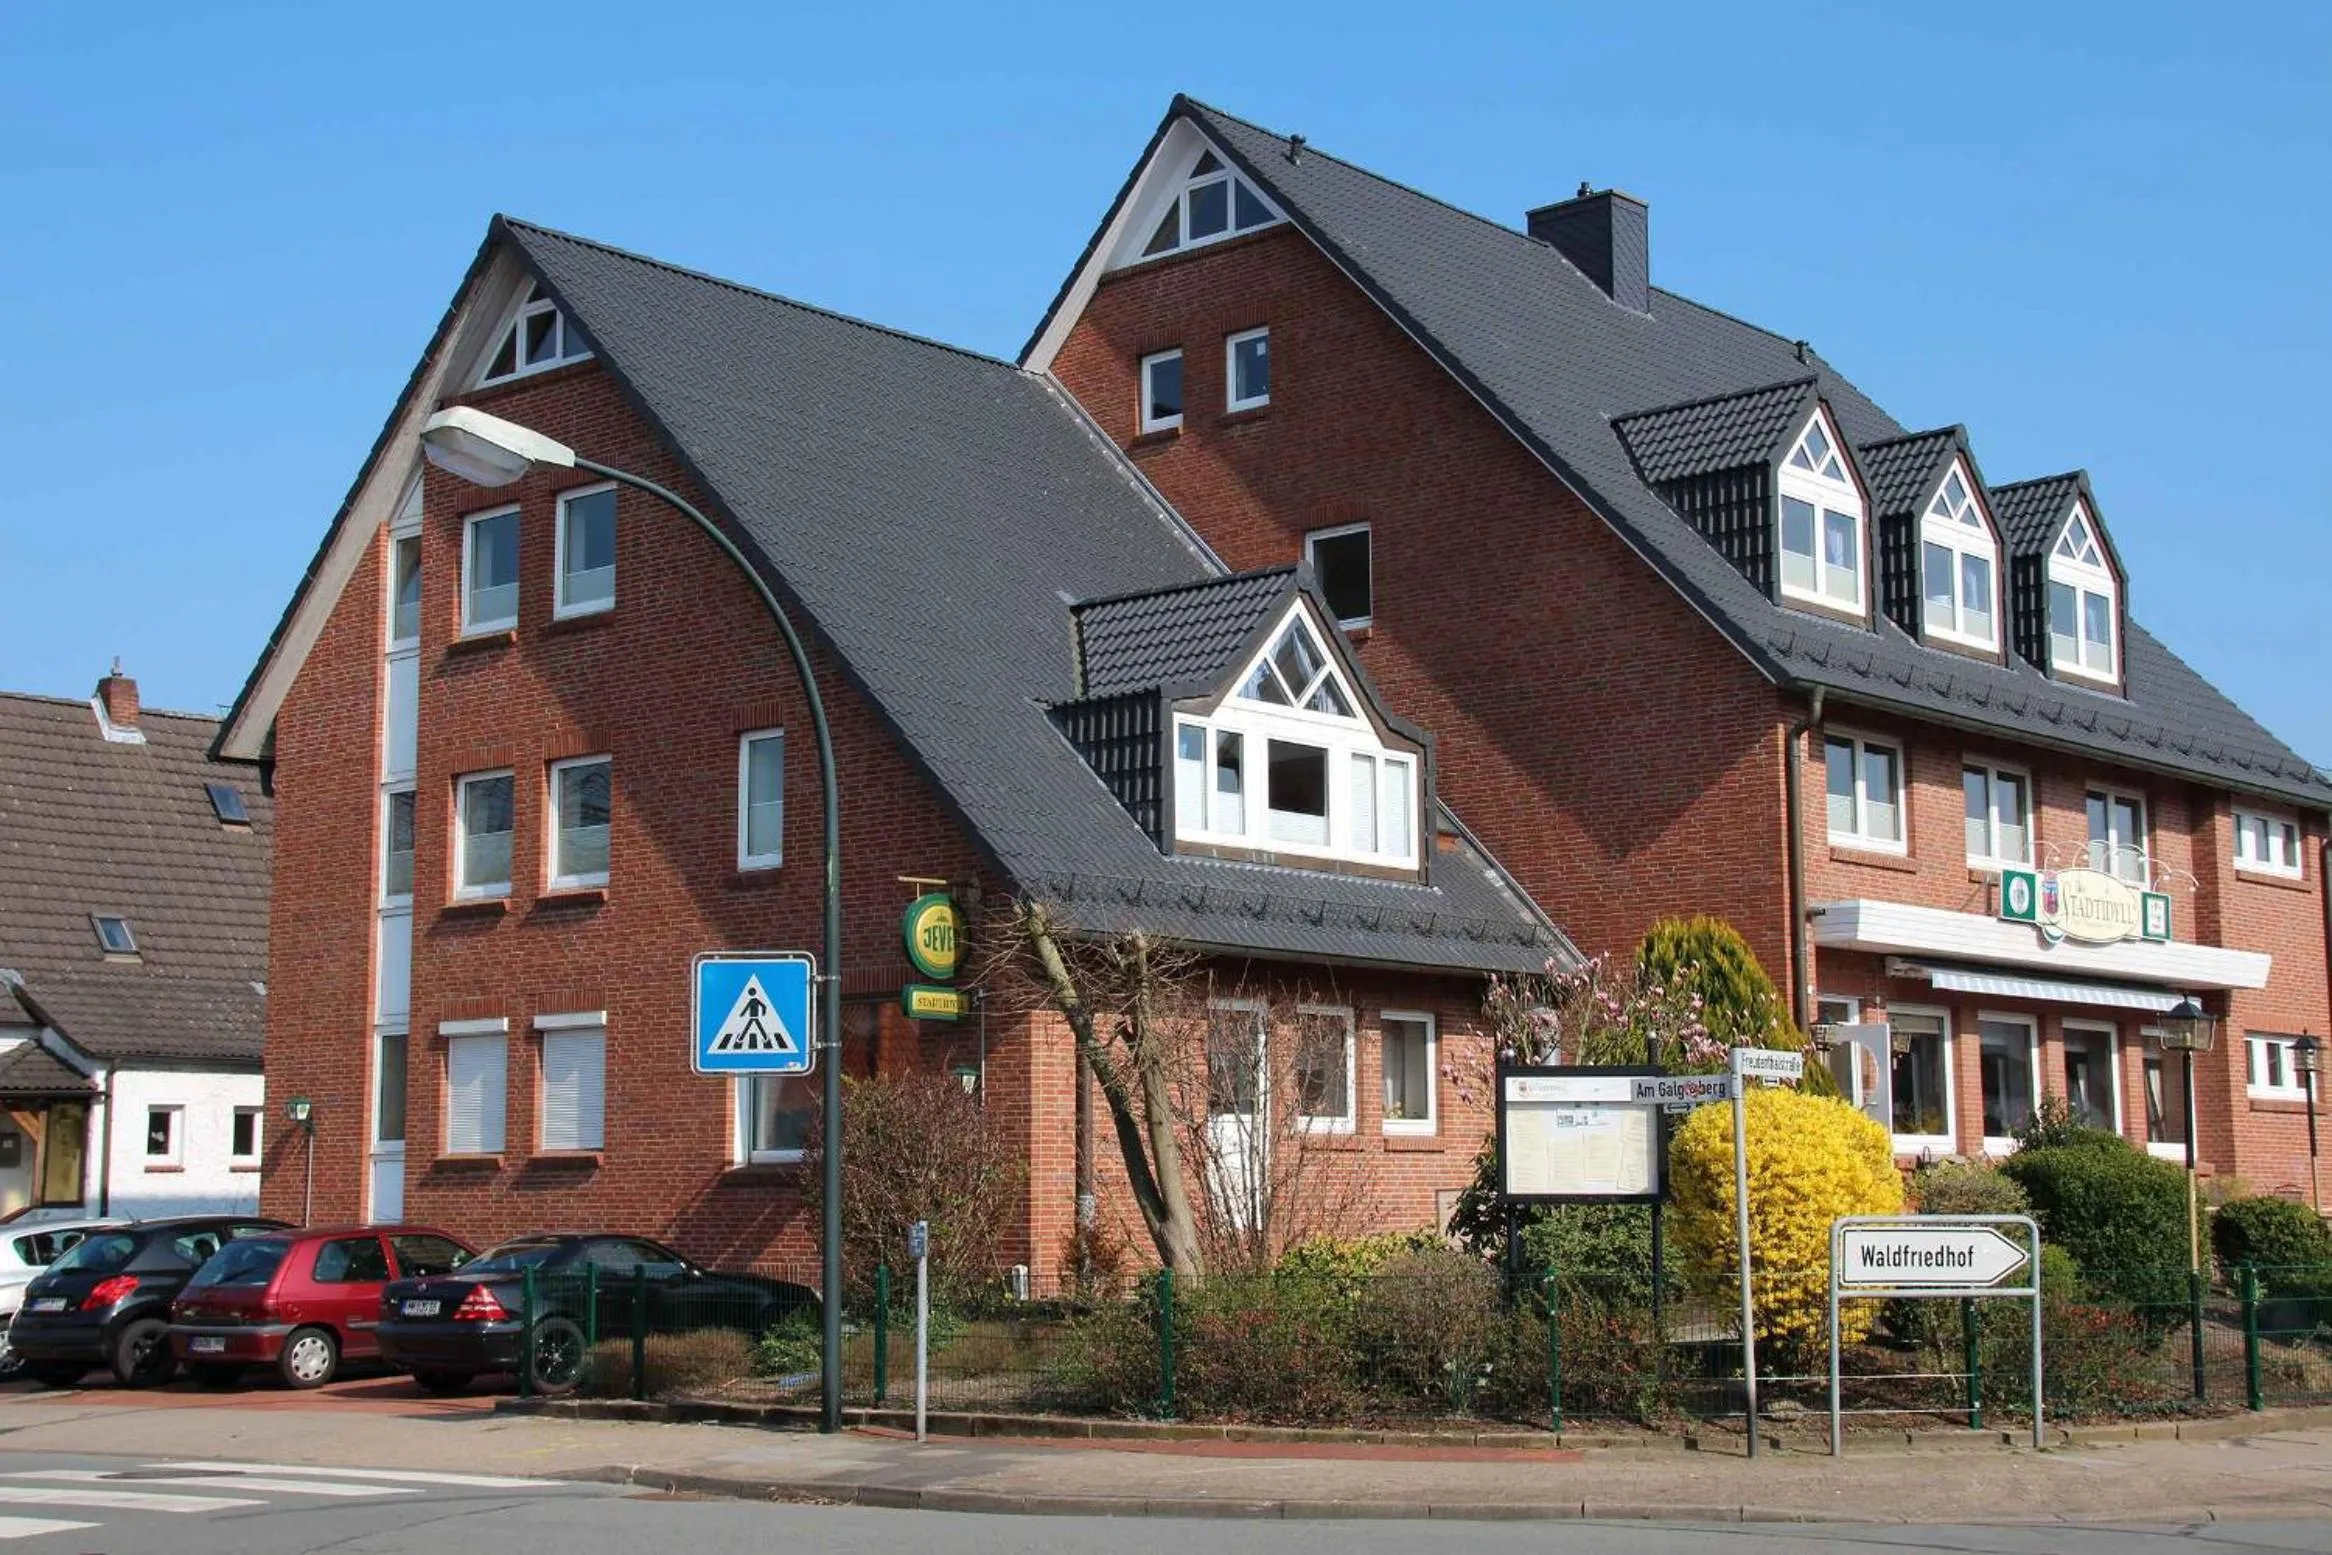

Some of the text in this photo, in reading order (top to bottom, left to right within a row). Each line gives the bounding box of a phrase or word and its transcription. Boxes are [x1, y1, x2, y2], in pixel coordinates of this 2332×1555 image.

[1637, 1080, 1726, 1099] Am Galgberg
[1861, 1244, 1974, 1268] Waldfriedhof
